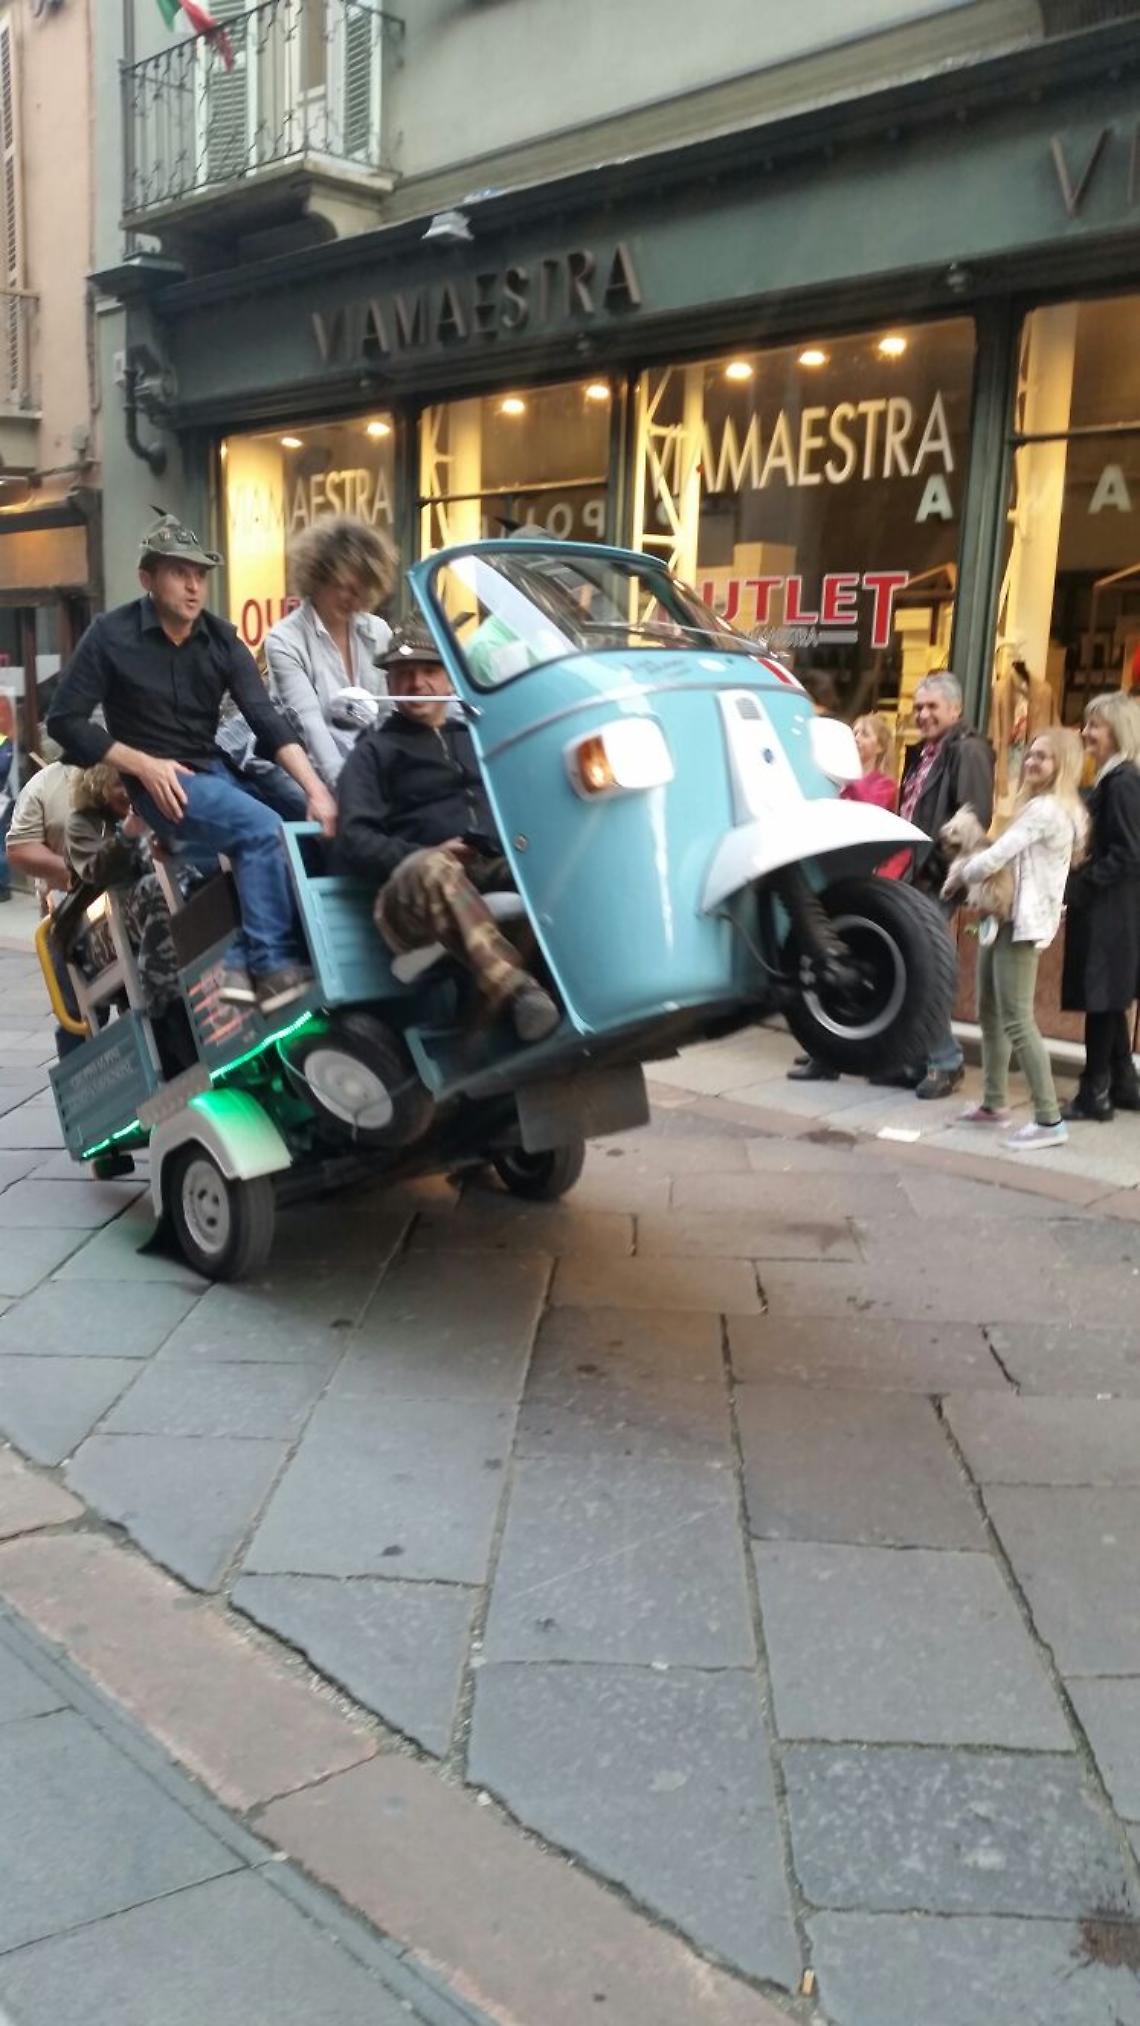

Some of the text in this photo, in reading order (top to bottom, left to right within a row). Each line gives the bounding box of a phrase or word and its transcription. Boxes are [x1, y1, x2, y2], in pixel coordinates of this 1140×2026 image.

[311, 241, 642, 363] VIAMAESTRA
[226, 467, 394, 534] AESTRA
[698, 571, 910, 649] UTLET
